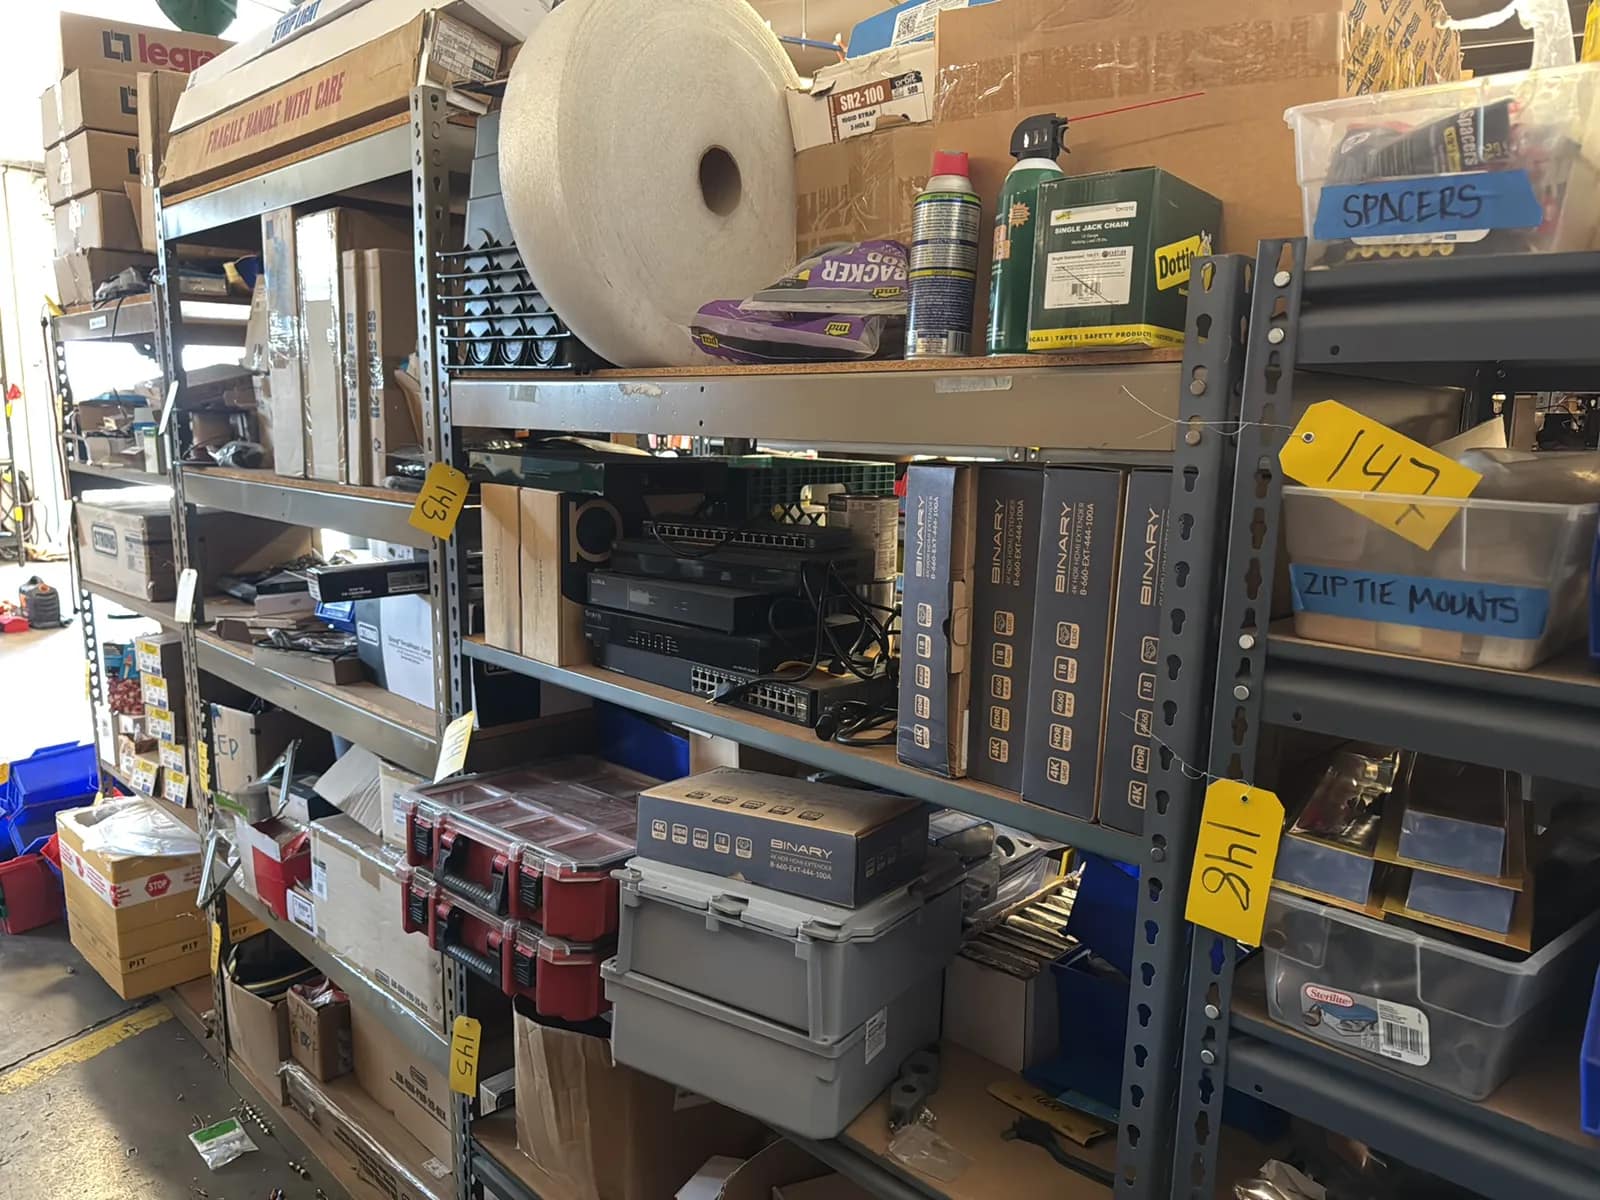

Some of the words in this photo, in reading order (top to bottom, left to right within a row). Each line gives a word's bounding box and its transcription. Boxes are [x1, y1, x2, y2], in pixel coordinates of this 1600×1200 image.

[271, 13, 297, 44] STRIP
[294, 0, 322, 30] LIGHT
[138, 32, 220, 74] legr
[840, 85, 884, 112] SR2-100
[207, 116, 245, 154] FRAGILE
[244, 99, 282, 139] HANDLE
[283, 86, 313, 124] WITH
[314, 71, 345, 111] CARE
[1343, 184, 1482, 228] SPACERS
[1054, 225, 1081, 235] SINGLE
[1082, 223, 1103, 232] JACK
[1104, 221, 1130, 230] CHAIN
[1085, 332, 1113, 340] SAFETY
[1115, 330, 1152, 339] PRODUCTS
[1327, 429, 1441, 525] 147
[420, 486, 458, 522] 143
[1074, 502, 1085, 543] EXTENDER
[915, 495, 925, 577] BINARY
[991, 498, 1005, 584] BINARY
[1013, 499, 1024, 587] B-660-EXT-444-100A
[1055, 501, 1072, 593] BINARY
[1073, 544, 1081, 565] HDMI
[1079, 503, 1094, 596] B-660-EXT-444-100A
[1140, 507, 1160, 606] BINARY
[1302, 572, 1348, 597] ZIP
[1356, 577, 1396, 606] TIE
[1408, 583, 1520, 624] MOUNTS
[996, 649, 1004, 661] 18
[1058, 663, 1067, 676] 18
[1142, 681, 1153, 693] 18
[1056, 693, 1065, 712] 4K60
[993, 708, 1001, 727] HDR
[916, 728, 923, 744] 4K
[1053, 726, 1062, 747] HDR
[991, 741, 1000, 756] 4K
[1135, 748, 1145, 769] HDR
[1050, 762, 1059, 779] 4K
[1131, 784, 1143, 804] 4K
[770, 838, 833, 860] BINARY
[1200, 820, 1261, 912] 148
[148, 878, 168, 891] STOP
[232, 926, 248, 937] PIT
[182, 941, 199, 952] PIT
[128, 958, 147, 969] PIT
[1310, 988, 1352, 1006] Sterilite
[455, 1034, 475, 1077] 145
